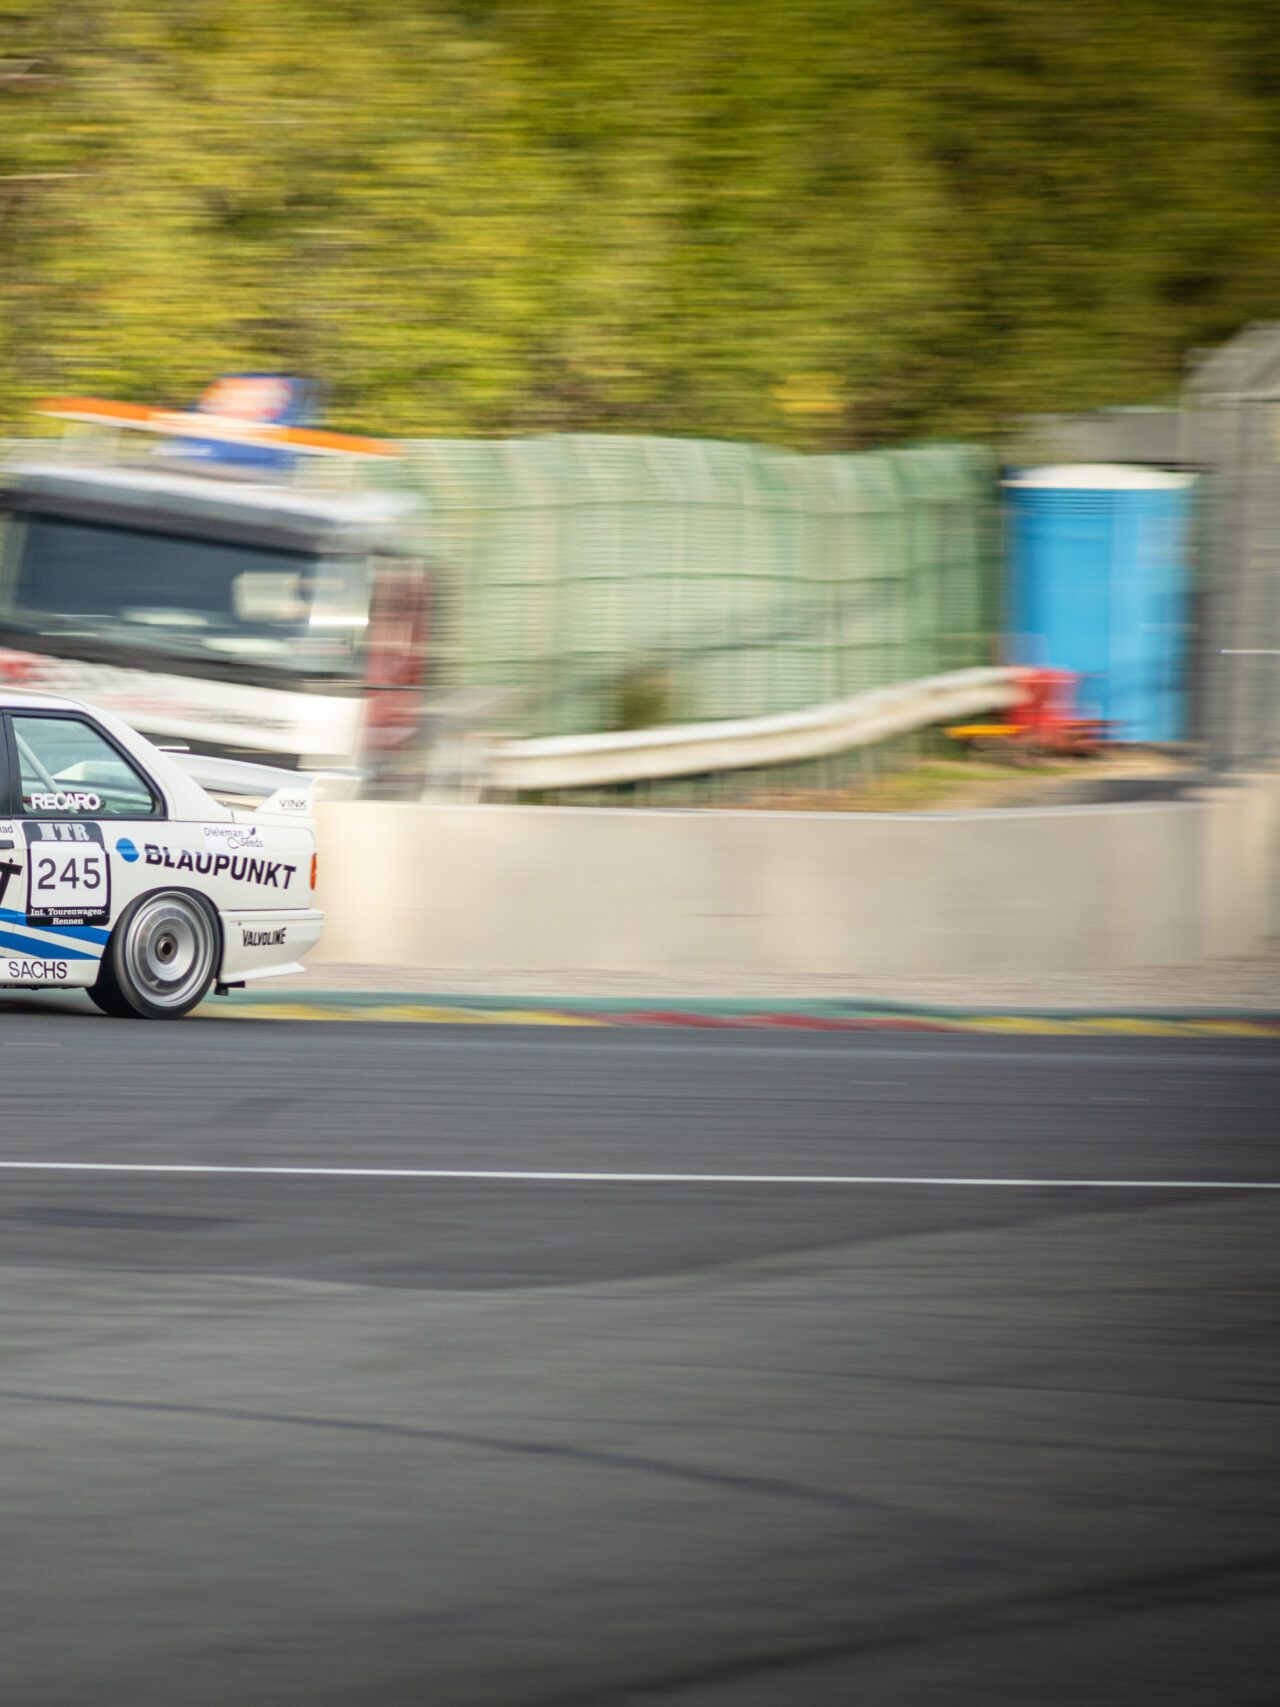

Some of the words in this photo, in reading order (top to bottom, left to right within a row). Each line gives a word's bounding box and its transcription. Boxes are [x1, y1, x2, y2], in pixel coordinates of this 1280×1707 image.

[30, 792, 101, 810] RECARO
[37, 857, 101, 890] 245
[144, 843, 297, 890] BLAUPUNKT
[30, 908, 46, 917] Int.
[47, 908, 106, 917] Tourenwagen-
[52, 917, 84, 925] Rennen
[241, 927, 287, 947] VALVOLINE
[7, 961, 68, 980] SACHS
